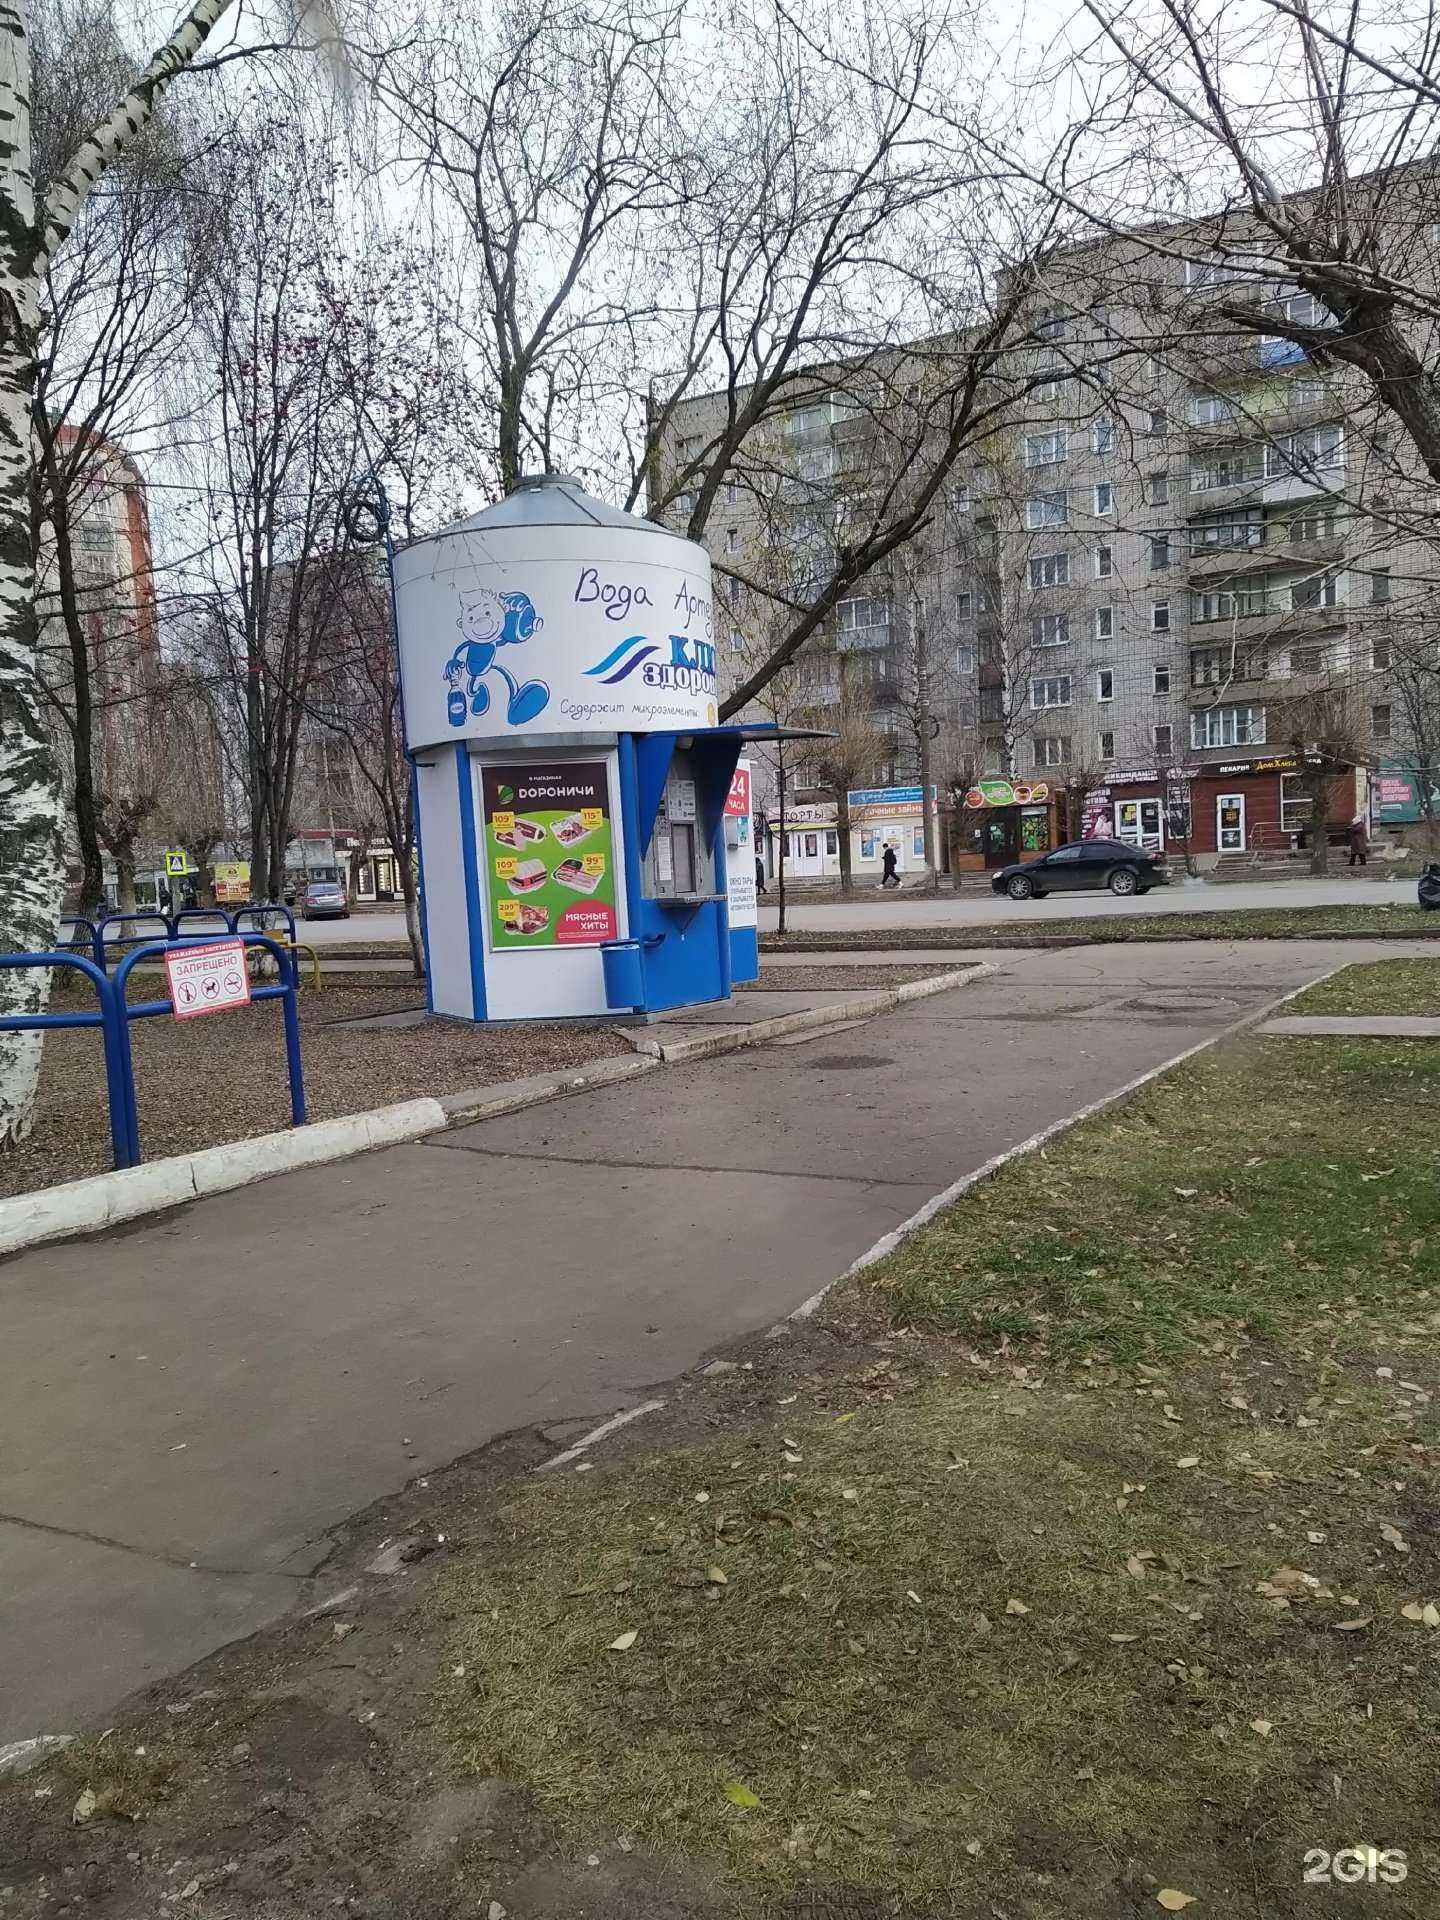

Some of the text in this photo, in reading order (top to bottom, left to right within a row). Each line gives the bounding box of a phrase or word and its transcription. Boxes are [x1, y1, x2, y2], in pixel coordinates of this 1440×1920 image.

[575, 567, 653, 620] Вода
[560, 699, 625, 720] Содержит
[729, 775, 746, 798] 24
[728, 799, 745, 811] ЧАСА
[783, 808, 824, 822] ТОРТЫ
[566, 912, 609, 922] МЯСНЫЕ
[580, 922, 609, 930] ХИТЫ
[176, 955, 238, 976] ЗАПРЕЩЕНО
